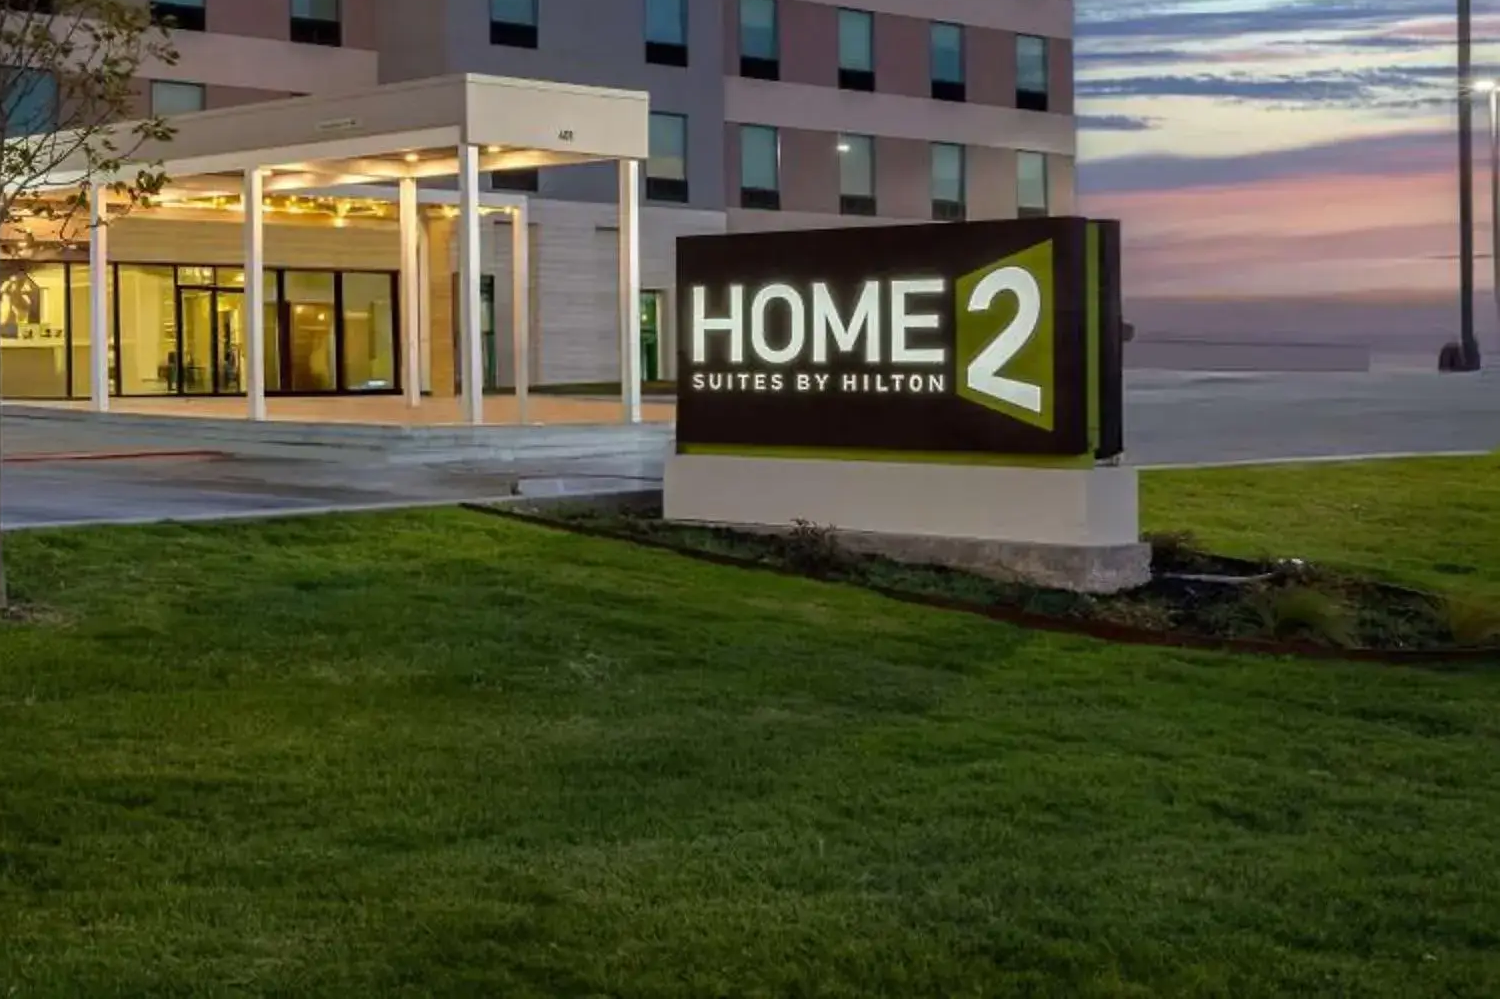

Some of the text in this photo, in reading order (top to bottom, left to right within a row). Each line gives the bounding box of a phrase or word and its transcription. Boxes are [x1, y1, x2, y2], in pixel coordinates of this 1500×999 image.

[692, 266, 1041, 413] HOME 2
[692, 374, 945, 392] SUITES BY HILTON
